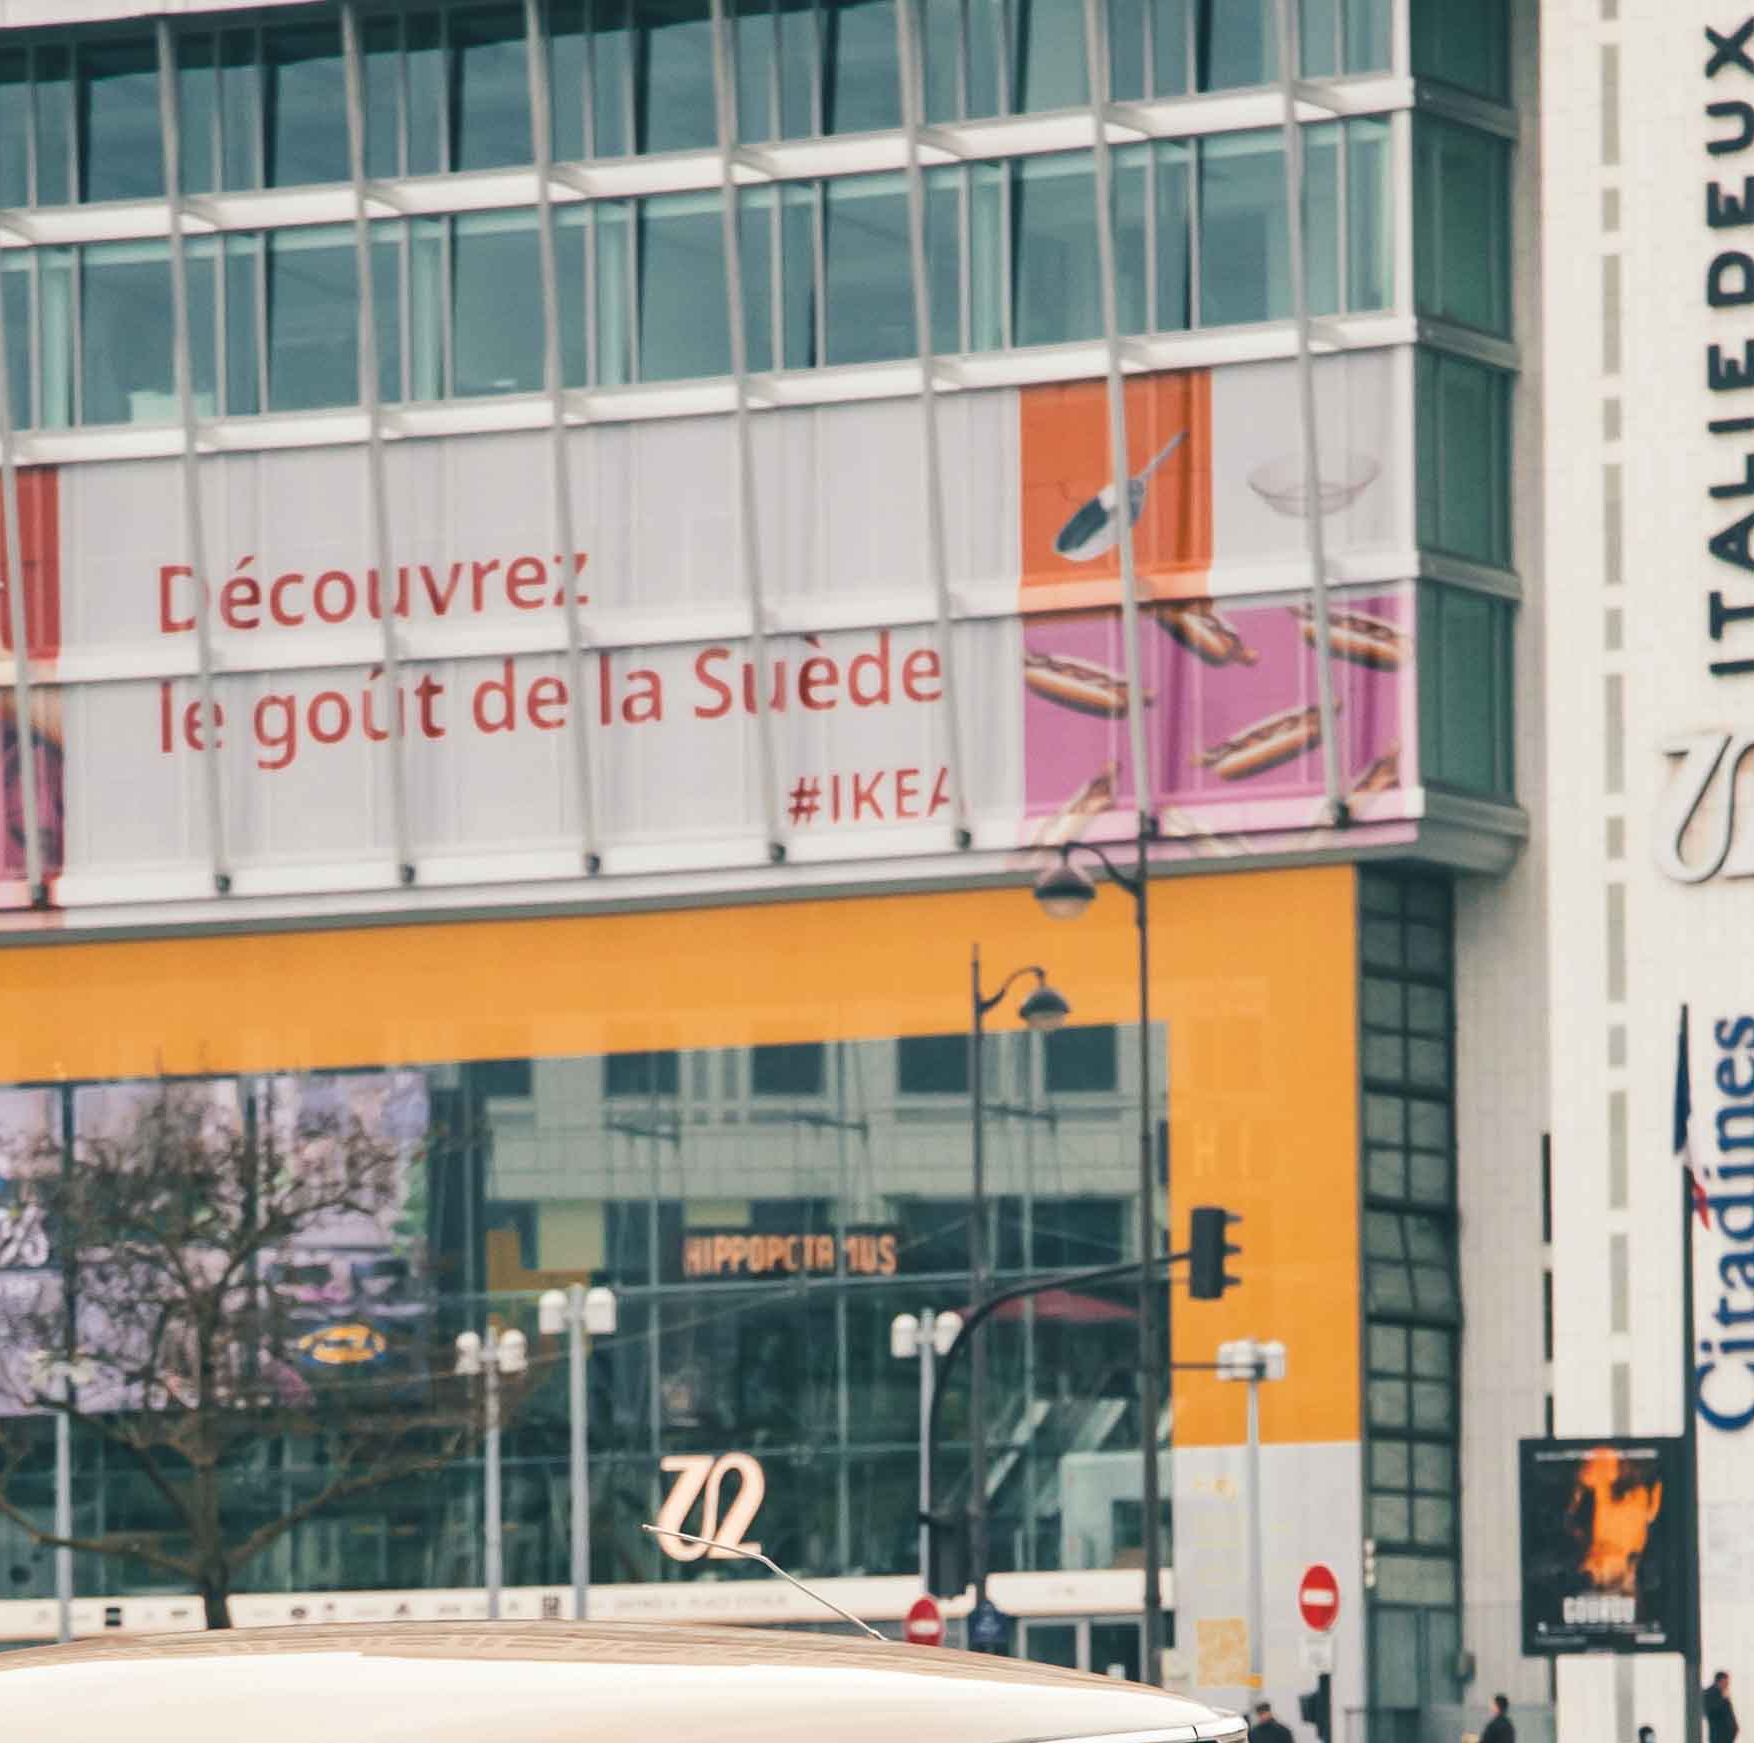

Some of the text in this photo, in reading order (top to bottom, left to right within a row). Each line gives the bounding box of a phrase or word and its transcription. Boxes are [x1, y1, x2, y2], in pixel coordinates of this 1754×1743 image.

[160, 679, 224, 753] le
[473, 656, 569, 735] de
[599, 650, 662, 726] la
[694, 629, 943, 720] Suède
